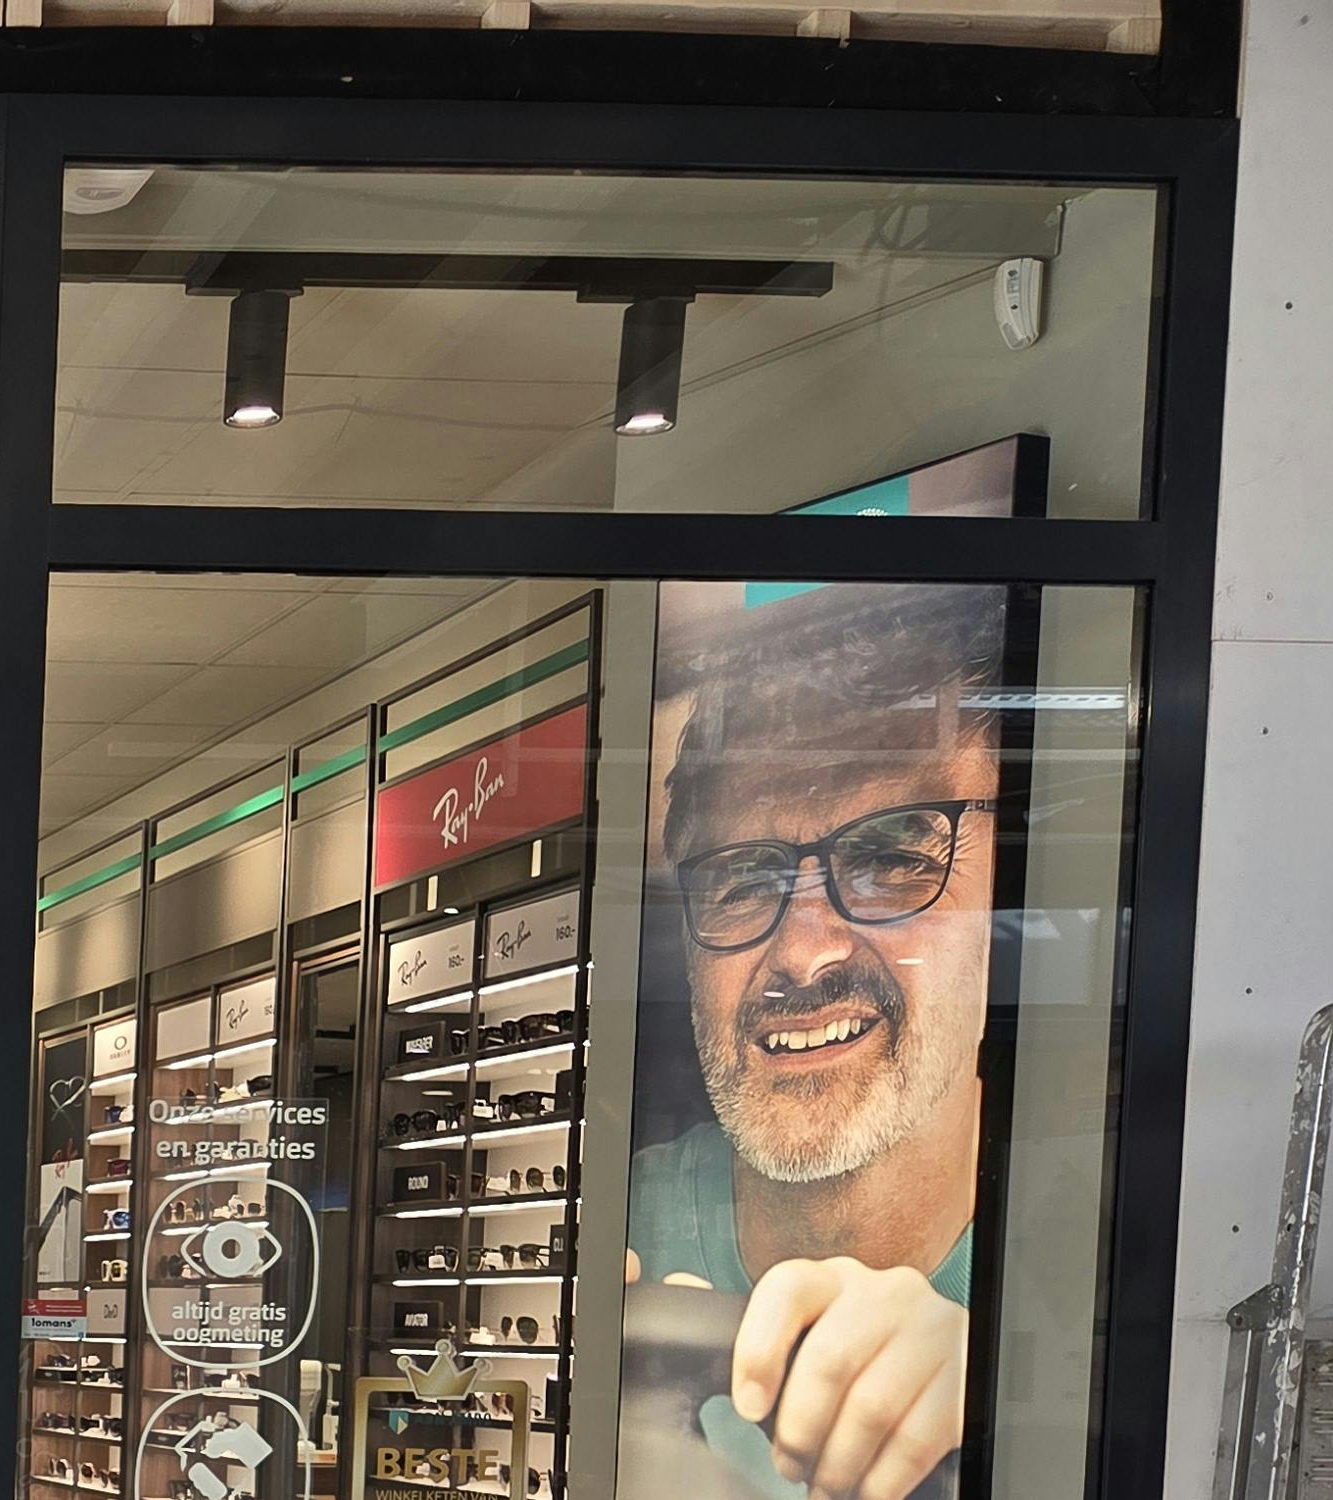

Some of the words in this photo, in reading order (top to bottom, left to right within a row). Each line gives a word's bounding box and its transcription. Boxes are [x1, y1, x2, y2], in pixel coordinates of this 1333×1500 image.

[432, 757, 504, 849] Ray-Ban
[148, 1100, 216, 1125] Onze
[223, 1099, 326, 1126] services
[156, 1139, 188, 1158] en
[194, 1138, 315, 1165] garanties
[172, 1302, 224, 1327] altijd
[228, 1302, 286, 1328] gratis
[173, 1325, 284, 1348] oogmeting
[376, 1447, 500, 1482] BESTE
